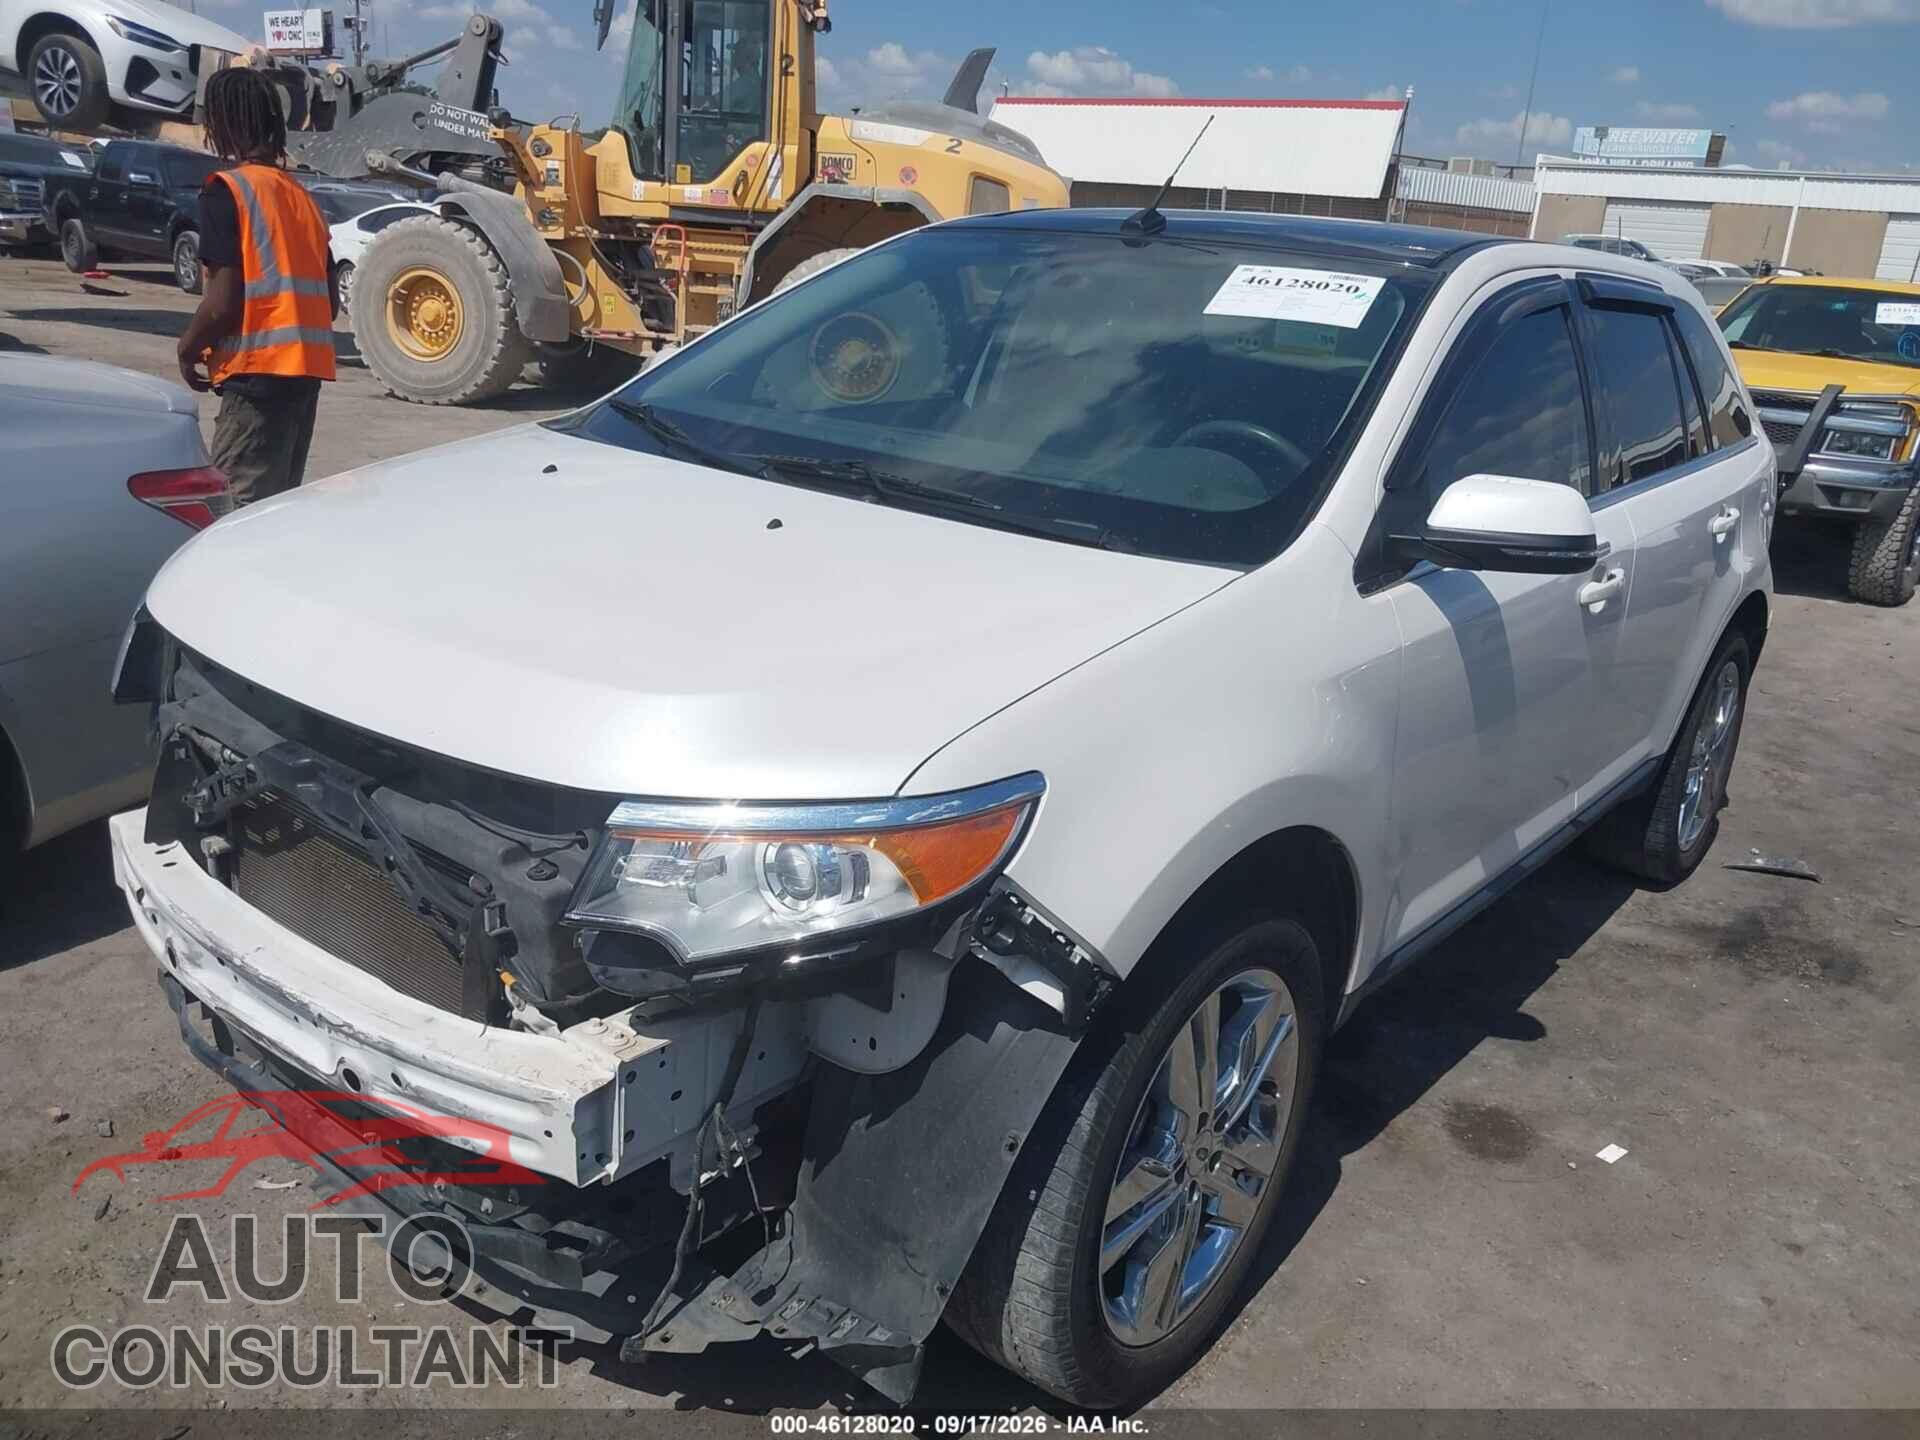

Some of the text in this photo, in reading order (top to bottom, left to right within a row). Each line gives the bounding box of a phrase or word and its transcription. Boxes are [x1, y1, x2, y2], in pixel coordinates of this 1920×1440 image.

[269, 15, 280, 27] WE
[272, 30, 287, 41] YU
[782, 53, 795, 77] 2
[429, 104, 445, 116] DO
[446, 108, 467, 121] NOT
[434, 118, 466, 137] UNDER
[944, 138, 963, 154] 2
[1641, 131, 1698, 145] WATER
[821, 155, 854, 171] ROMCO
[1242, 275, 1361, 295] 46128020
